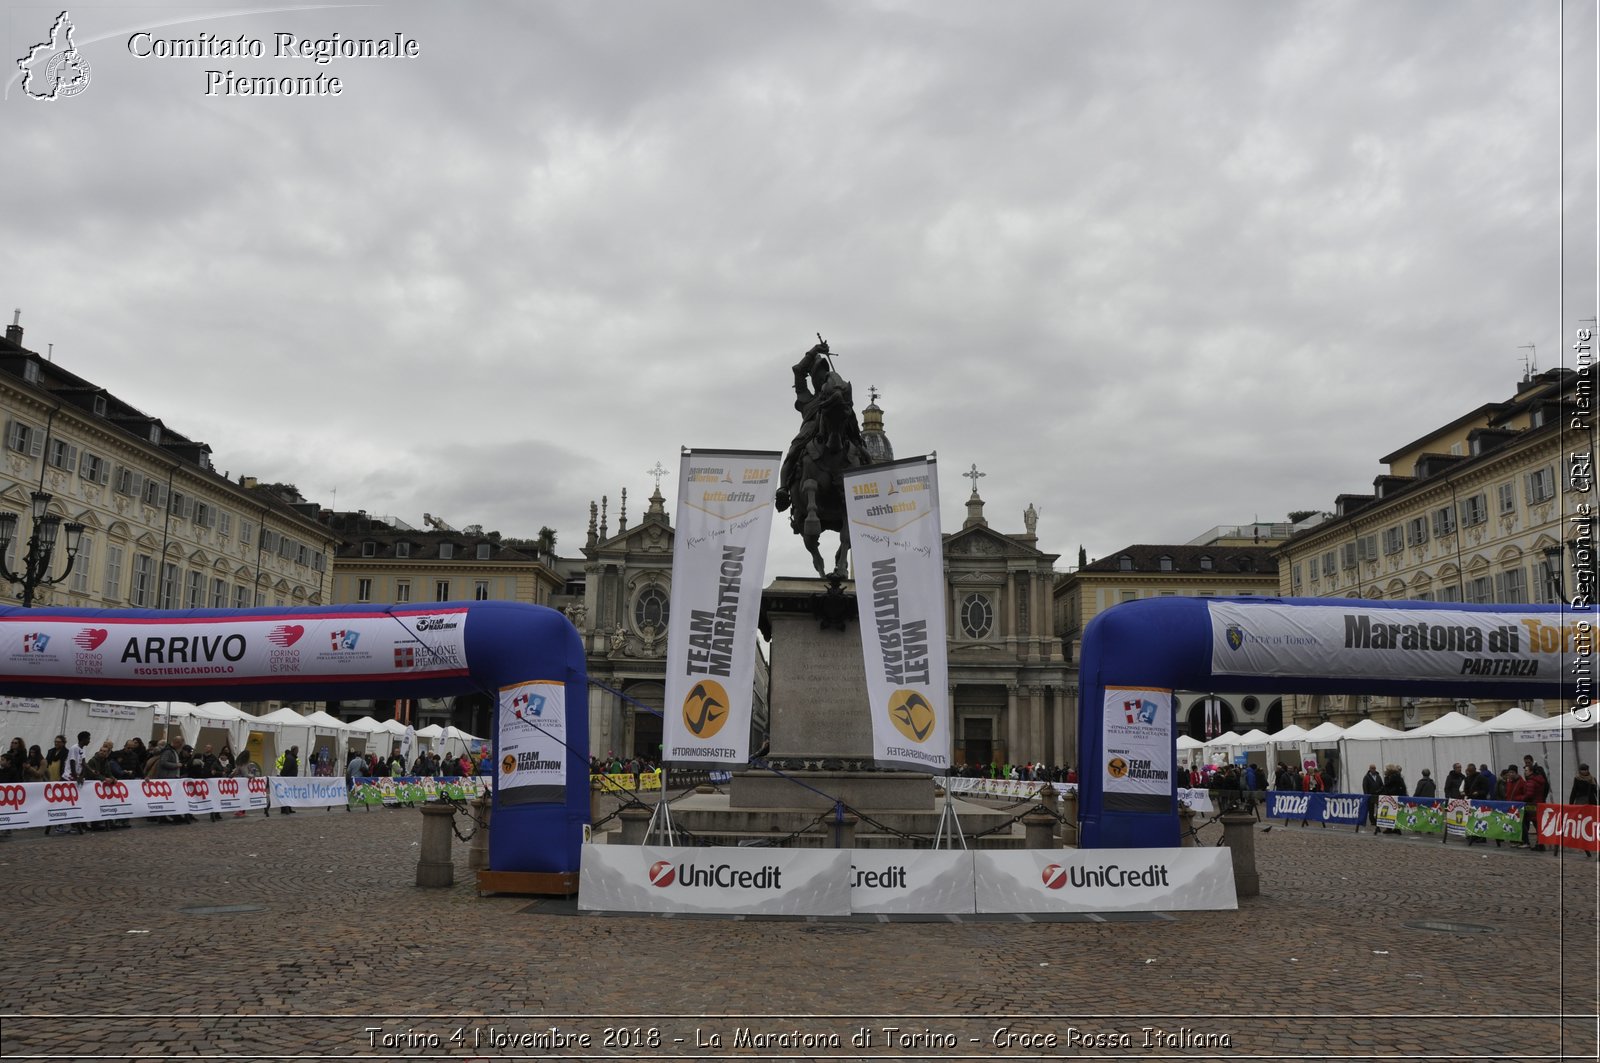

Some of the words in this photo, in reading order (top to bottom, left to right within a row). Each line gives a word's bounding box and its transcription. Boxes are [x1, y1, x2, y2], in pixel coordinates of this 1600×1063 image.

[703, 490, 755, 502] tuttadritta
[687, 536, 706, 549] Run
[708, 545, 746, 677] MARATHON
[1344, 614, 1483, 652] Maratona
[1488, 625, 1520, 653] di
[121, 634, 247, 664] ARRIVO
[686, 609, 715, 676] TEAM
[75, 652, 103, 660] TORINO
[270, 649, 300, 657] TORINO
[285, 656, 300, 664] RUN
[270, 664, 278, 672] IS
[280, 664, 300, 672] PINK
[415, 656, 460, 667] PIEMONTE
[1460, 658, 1539, 676] PARTENZA
[134, 665, 235, 676] #SOSTIENICANDIOLO
[518, 751, 539, 762] TEAM
[672, 747, 736, 759] #TORINOISFASTER
[517, 760, 561, 771] MARATHON
[1128, 759, 1152, 770] TEAM
[1128, 769, 1169, 780] MARATHON
[44, 783, 79, 806] coop
[95, 781, 129, 803] coop
[142, 780, 172, 801] coop
[217, 779, 239, 798] coop
[275, 783, 311, 799] Central
[312, 783, 347, 799] Motors
[0, 785, 26, 811] oop
[1555, 812, 1600, 842] UniCr
[679, 864, 782, 889] UniCredit
[1070, 865, 1170, 888] UniCredit
